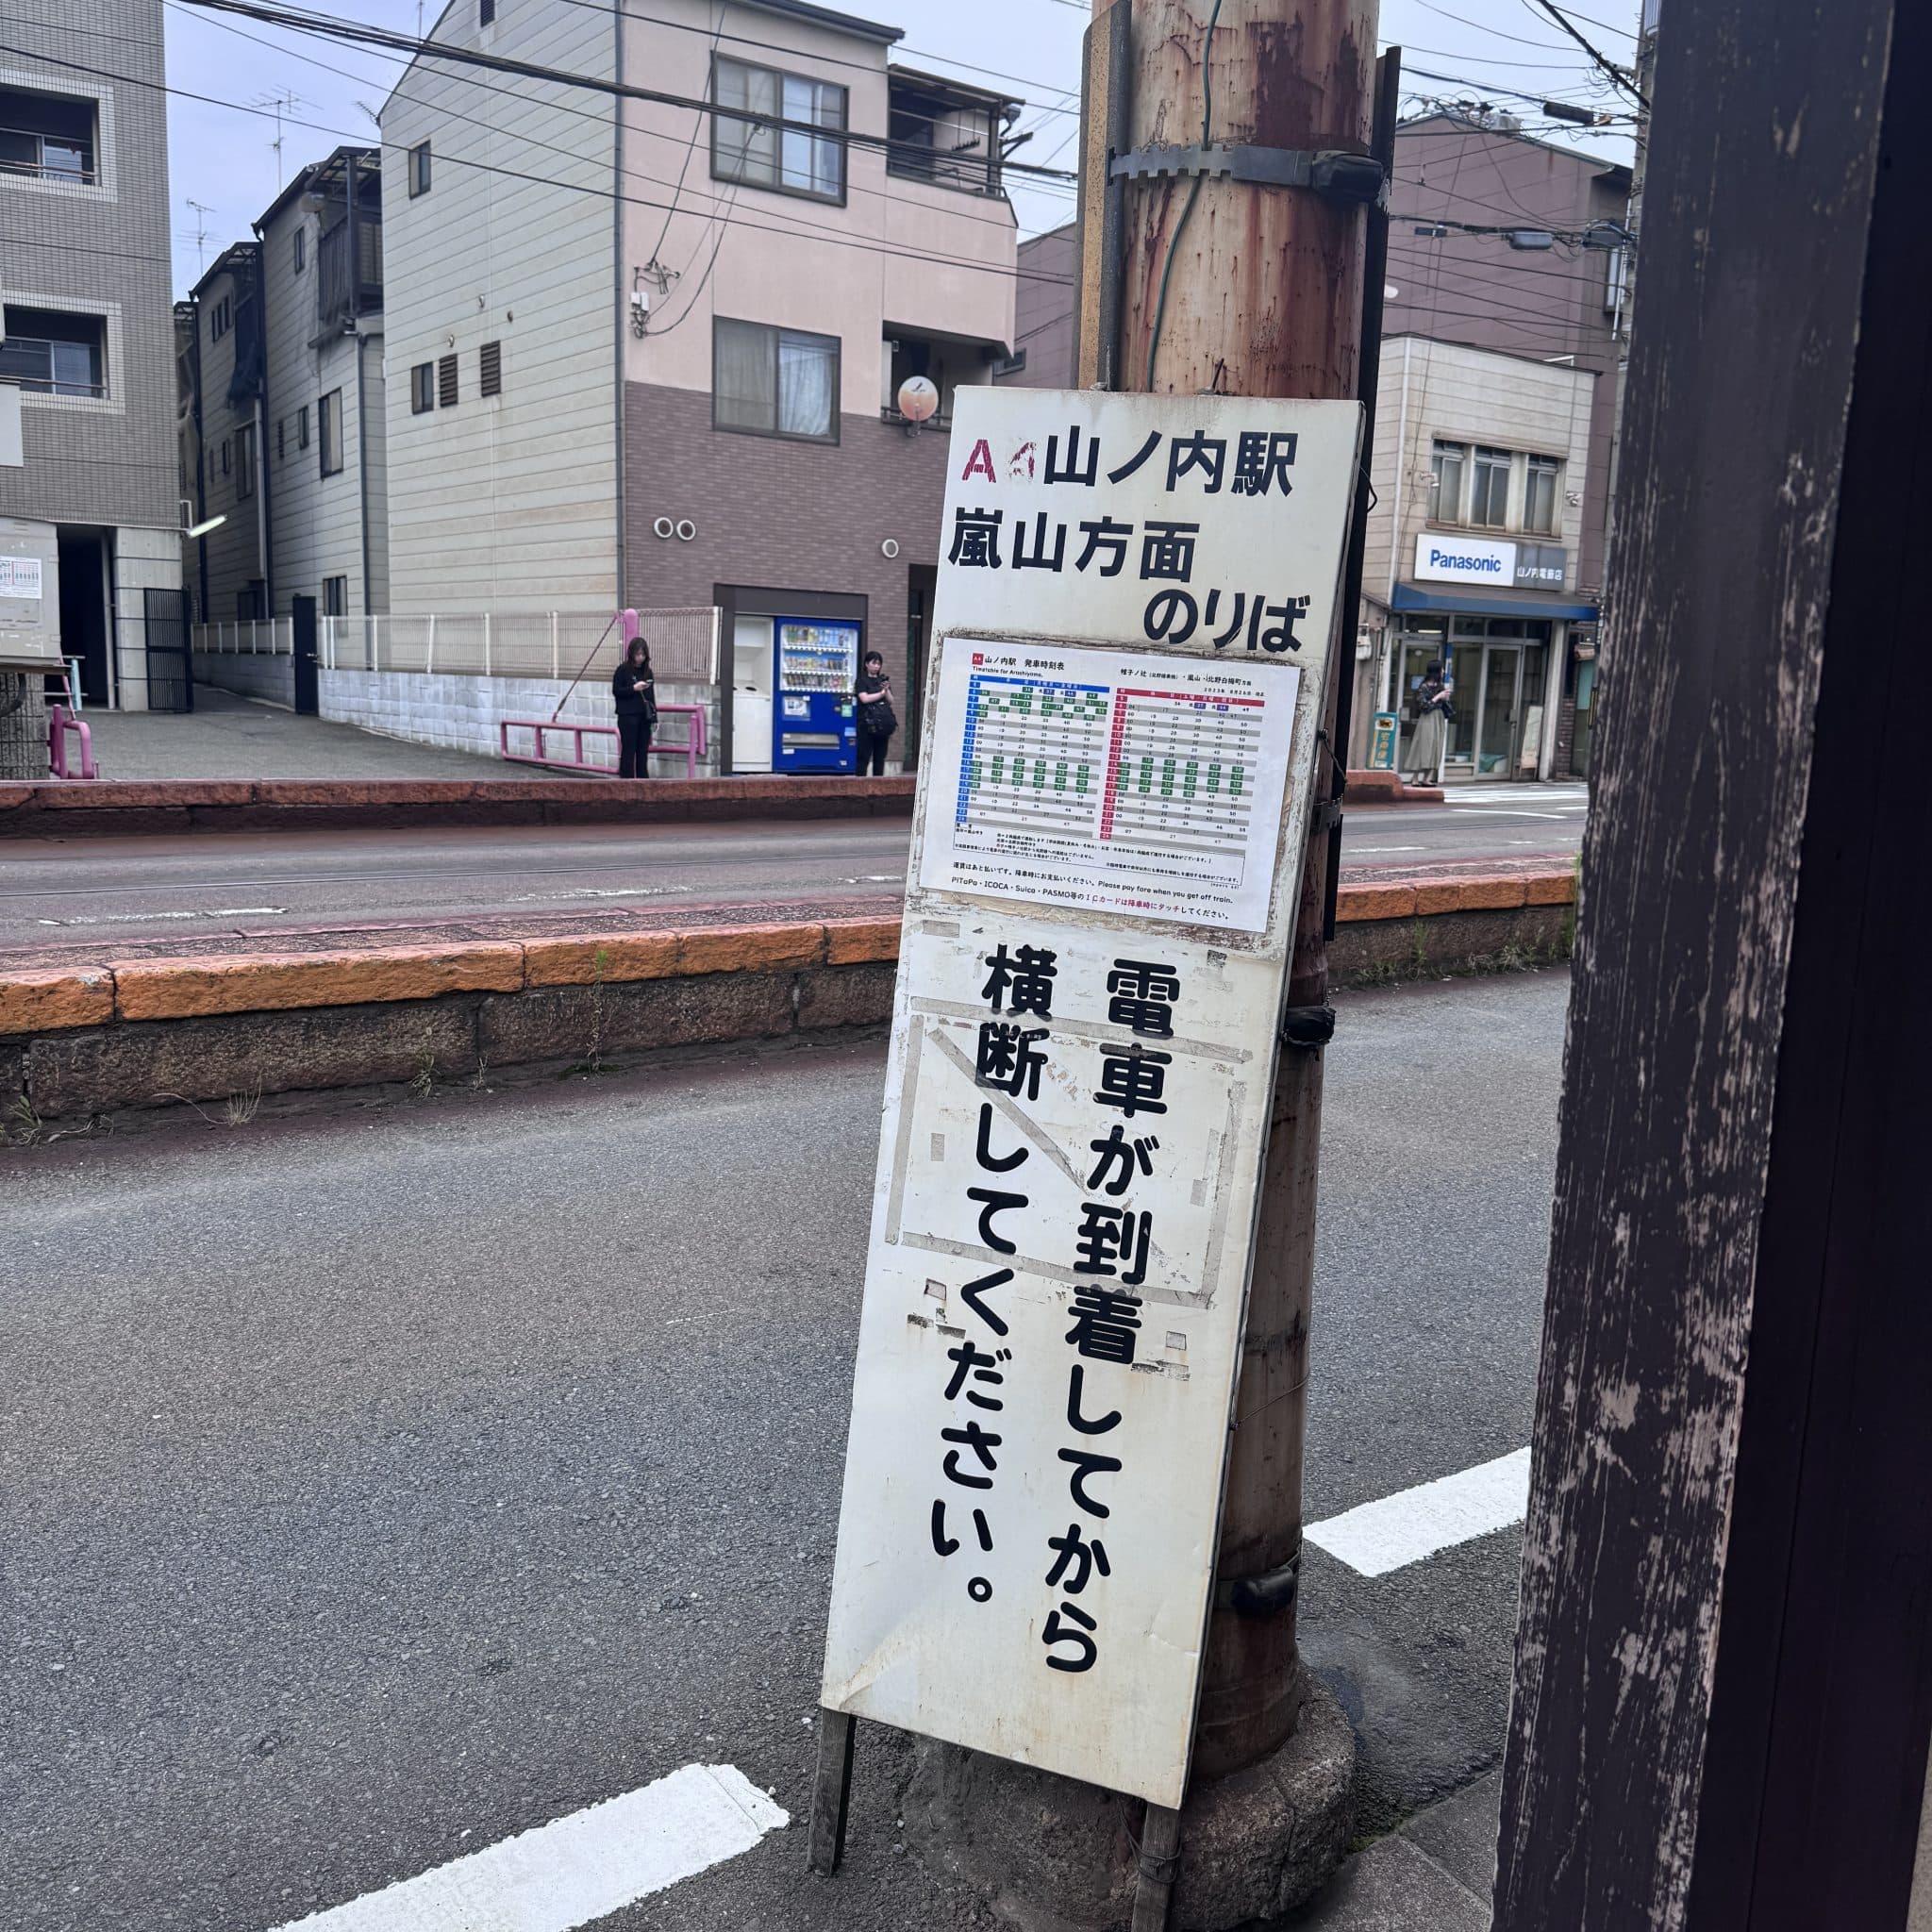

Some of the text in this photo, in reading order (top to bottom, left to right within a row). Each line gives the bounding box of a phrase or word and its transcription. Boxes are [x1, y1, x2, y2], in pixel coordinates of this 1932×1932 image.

[1043, 425, 1298, 497] 山ノ内駅
[948, 507, 1200, 583] 嵐山方面
[1430, 549, 1502, 573] Panasonic
[1143, 589, 1310, 653] のりば
[1098, 880, 1121, 890] Please
[1153, 888, 1172, 896] when
[1173, 891, 1186, 899] you
[931, 943, 1058, 1602] 横断してください。
[1041, 958, 1180, 1673] 電車が到着してから
